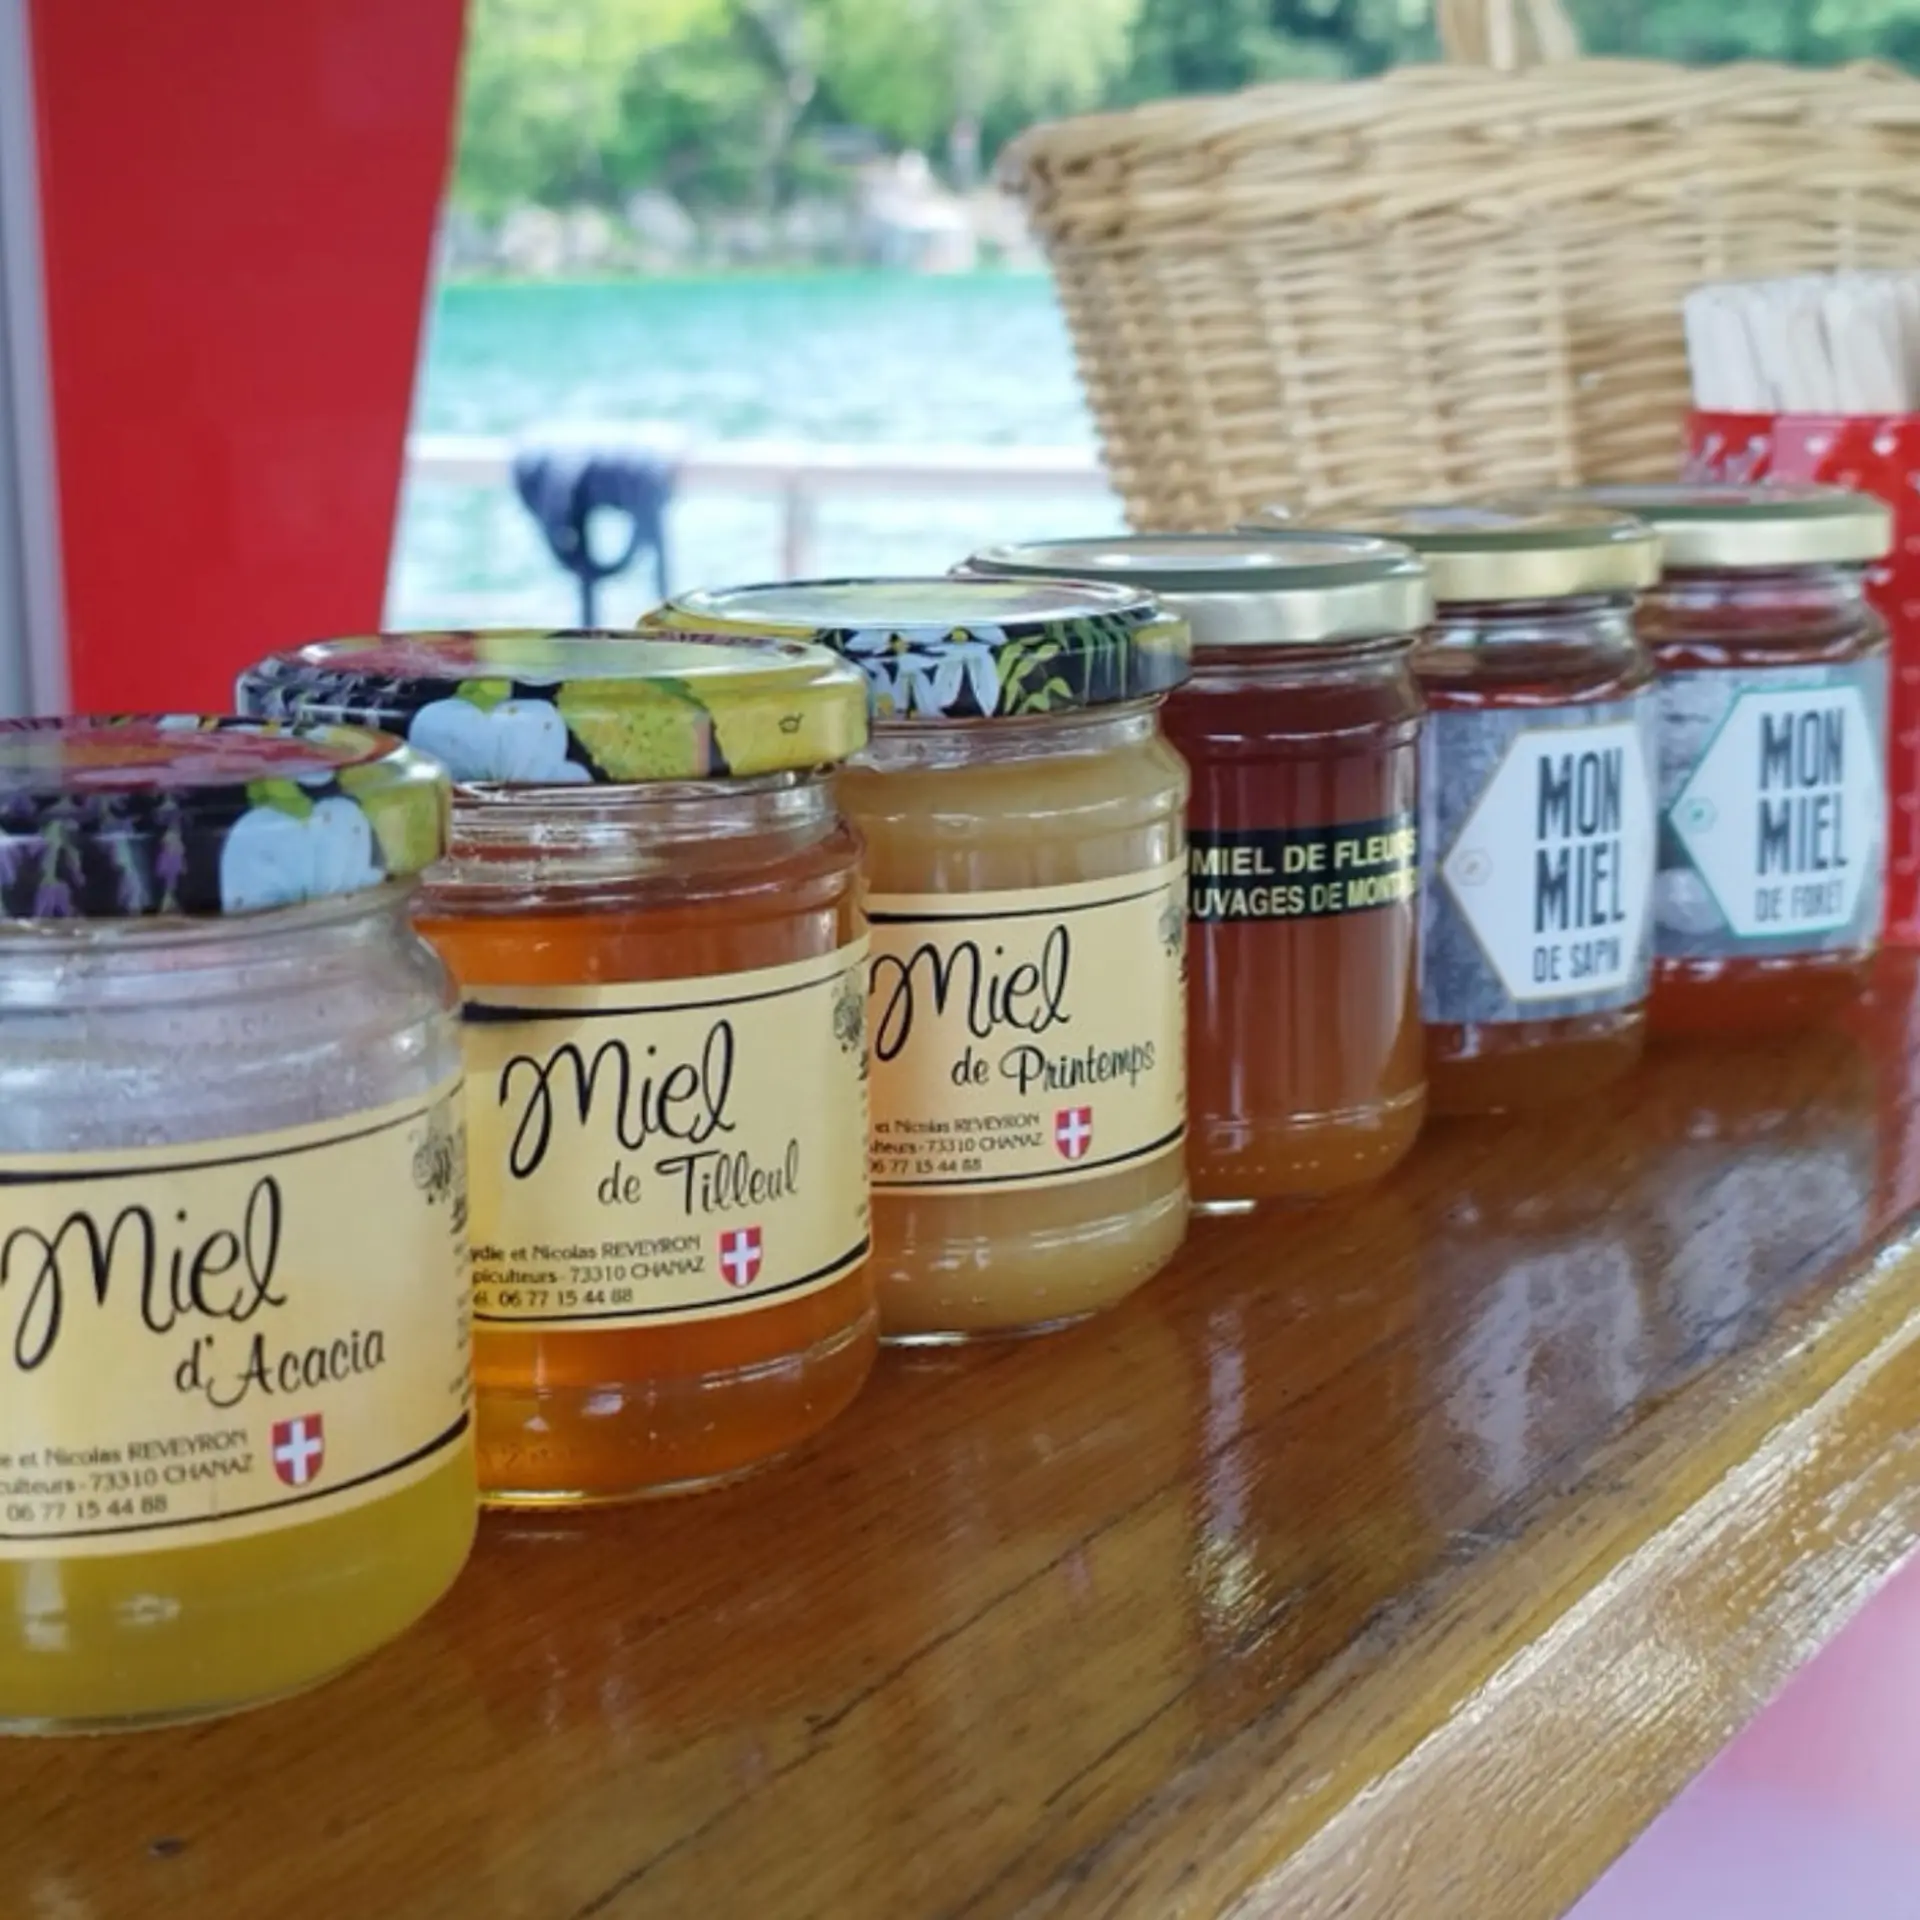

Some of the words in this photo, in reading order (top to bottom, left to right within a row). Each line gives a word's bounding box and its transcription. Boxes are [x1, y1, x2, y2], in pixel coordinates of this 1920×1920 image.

[1759, 708, 1844, 790] MON
[1538, 748, 1623, 841] MON
[1757, 792, 1848, 876] MIEL
[1191, 846, 1275, 876] MIEL
[1283, 843, 1327, 873] DE
[1310, 882, 1342, 912] DE
[1535, 839, 1626, 933] MIEL
[1754, 887, 1783, 922] DE
[1533, 945, 1562, 983] DE
[869, 924, 1071, 1061] Miel
[951, 1046, 990, 1087] de
[999, 1040, 1155, 1096] Printemps
[499, 1019, 736, 1180] Miel
[954, 1112, 1040, 1133] REVEYRON
[979, 1132, 1044, 1151] CHANAZ
[597, 1160, 641, 1204] de
[655, 1139, 799, 1216] Tilleul
[510, 1247, 527, 1261] et
[532, 1244, 597, 1261] Nicolas
[601, 1234, 700, 1258] REVEYRON
[1, 1174, 287, 1372] Miel
[569, 1264, 626, 1284] 73310
[630, 1258, 704, 1282] CHANAZ
[527, 1290, 549, 1308] 77
[557, 1290, 578, 1306] 15
[584, 1288, 605, 1304] 44
[45, 1447, 121, 1467] Nicolas
[127, 1428, 248, 1461] REVEYRON
[90, 1467, 157, 1493] 73310
[163, 1453, 253, 1483] CHANAZ
[40, 1502, 66, 1521] 77
[77, 1499, 101, 1519] 15
[106, 1497, 134, 1517] 44
[140, 1494, 168, 1514] 88
